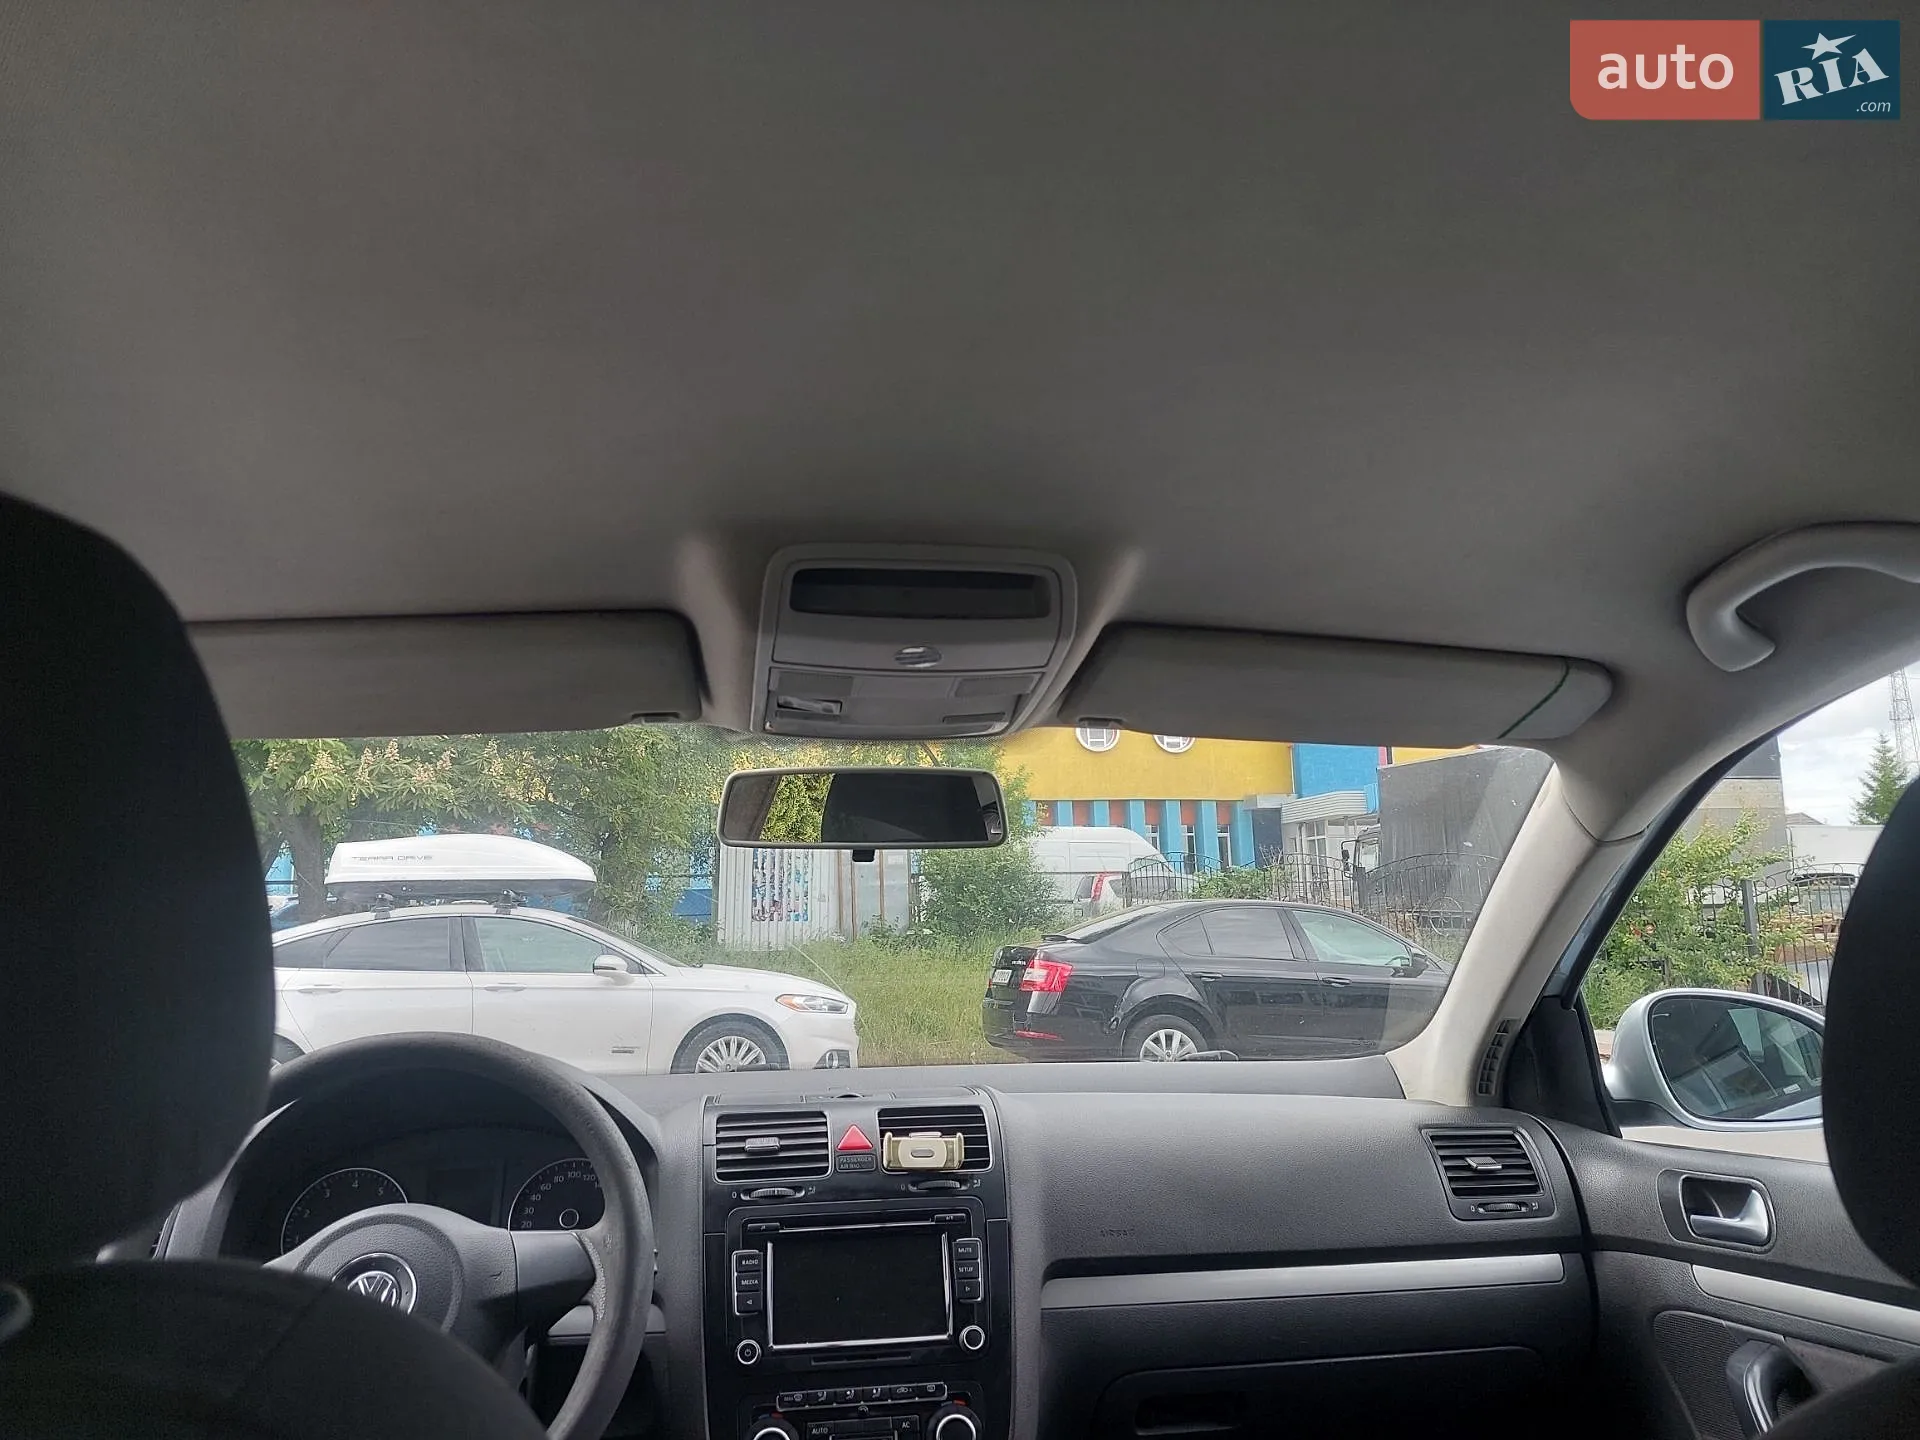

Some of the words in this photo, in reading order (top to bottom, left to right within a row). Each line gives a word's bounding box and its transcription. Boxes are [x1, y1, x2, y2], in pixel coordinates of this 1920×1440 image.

[567, 1171, 581, 1179] 100
[351, 1180, 359, 1189] 4
[540, 1183, 552, 1191] 60
[530, 1193, 541, 1201] 40
[524, 1206, 534, 1215] 30
[521, 1220, 532, 1229] 20
[811, 1427, 829, 1435] AUTO
